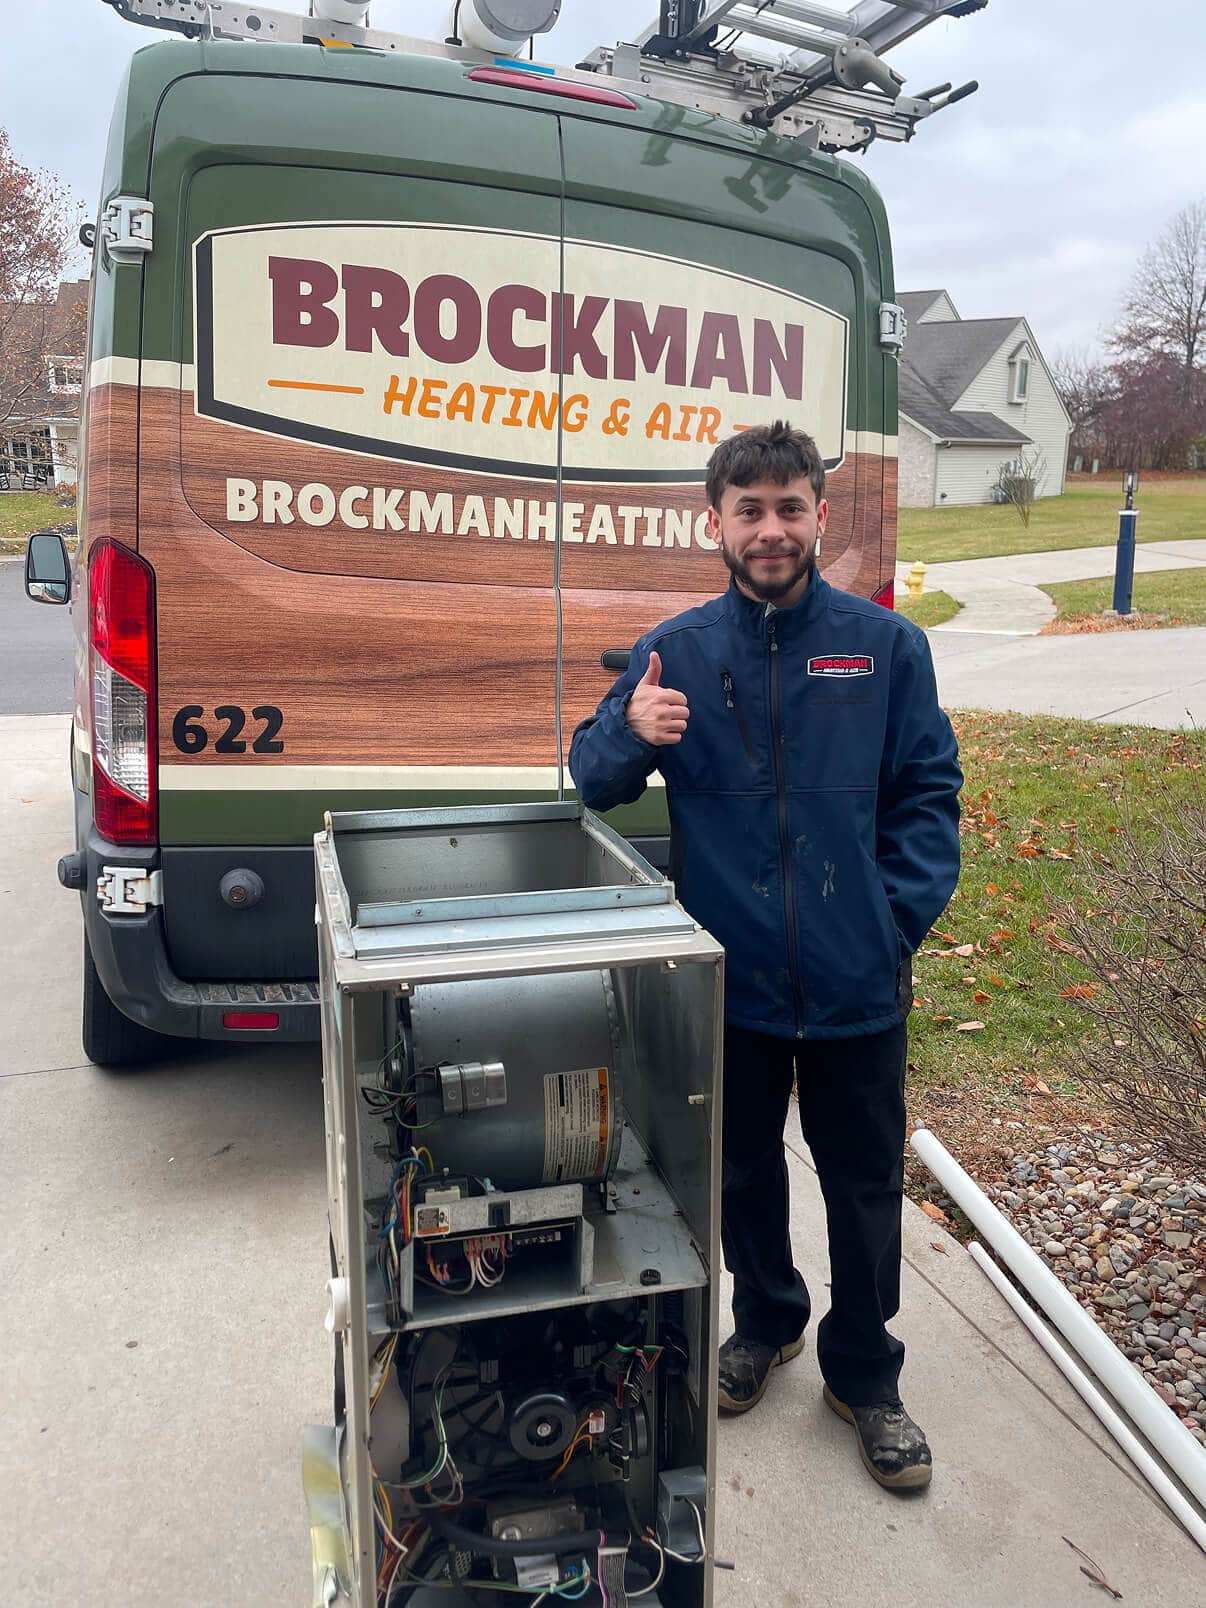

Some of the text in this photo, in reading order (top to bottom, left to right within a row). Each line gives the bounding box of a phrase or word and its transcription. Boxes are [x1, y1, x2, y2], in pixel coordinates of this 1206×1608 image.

[268, 256, 804, 400] BROCKMAN
[384, 375, 722, 444] HEATING & AIR
[226, 478, 821, 556] BROCKMANHEATING
[172, 705, 285, 755] 622
